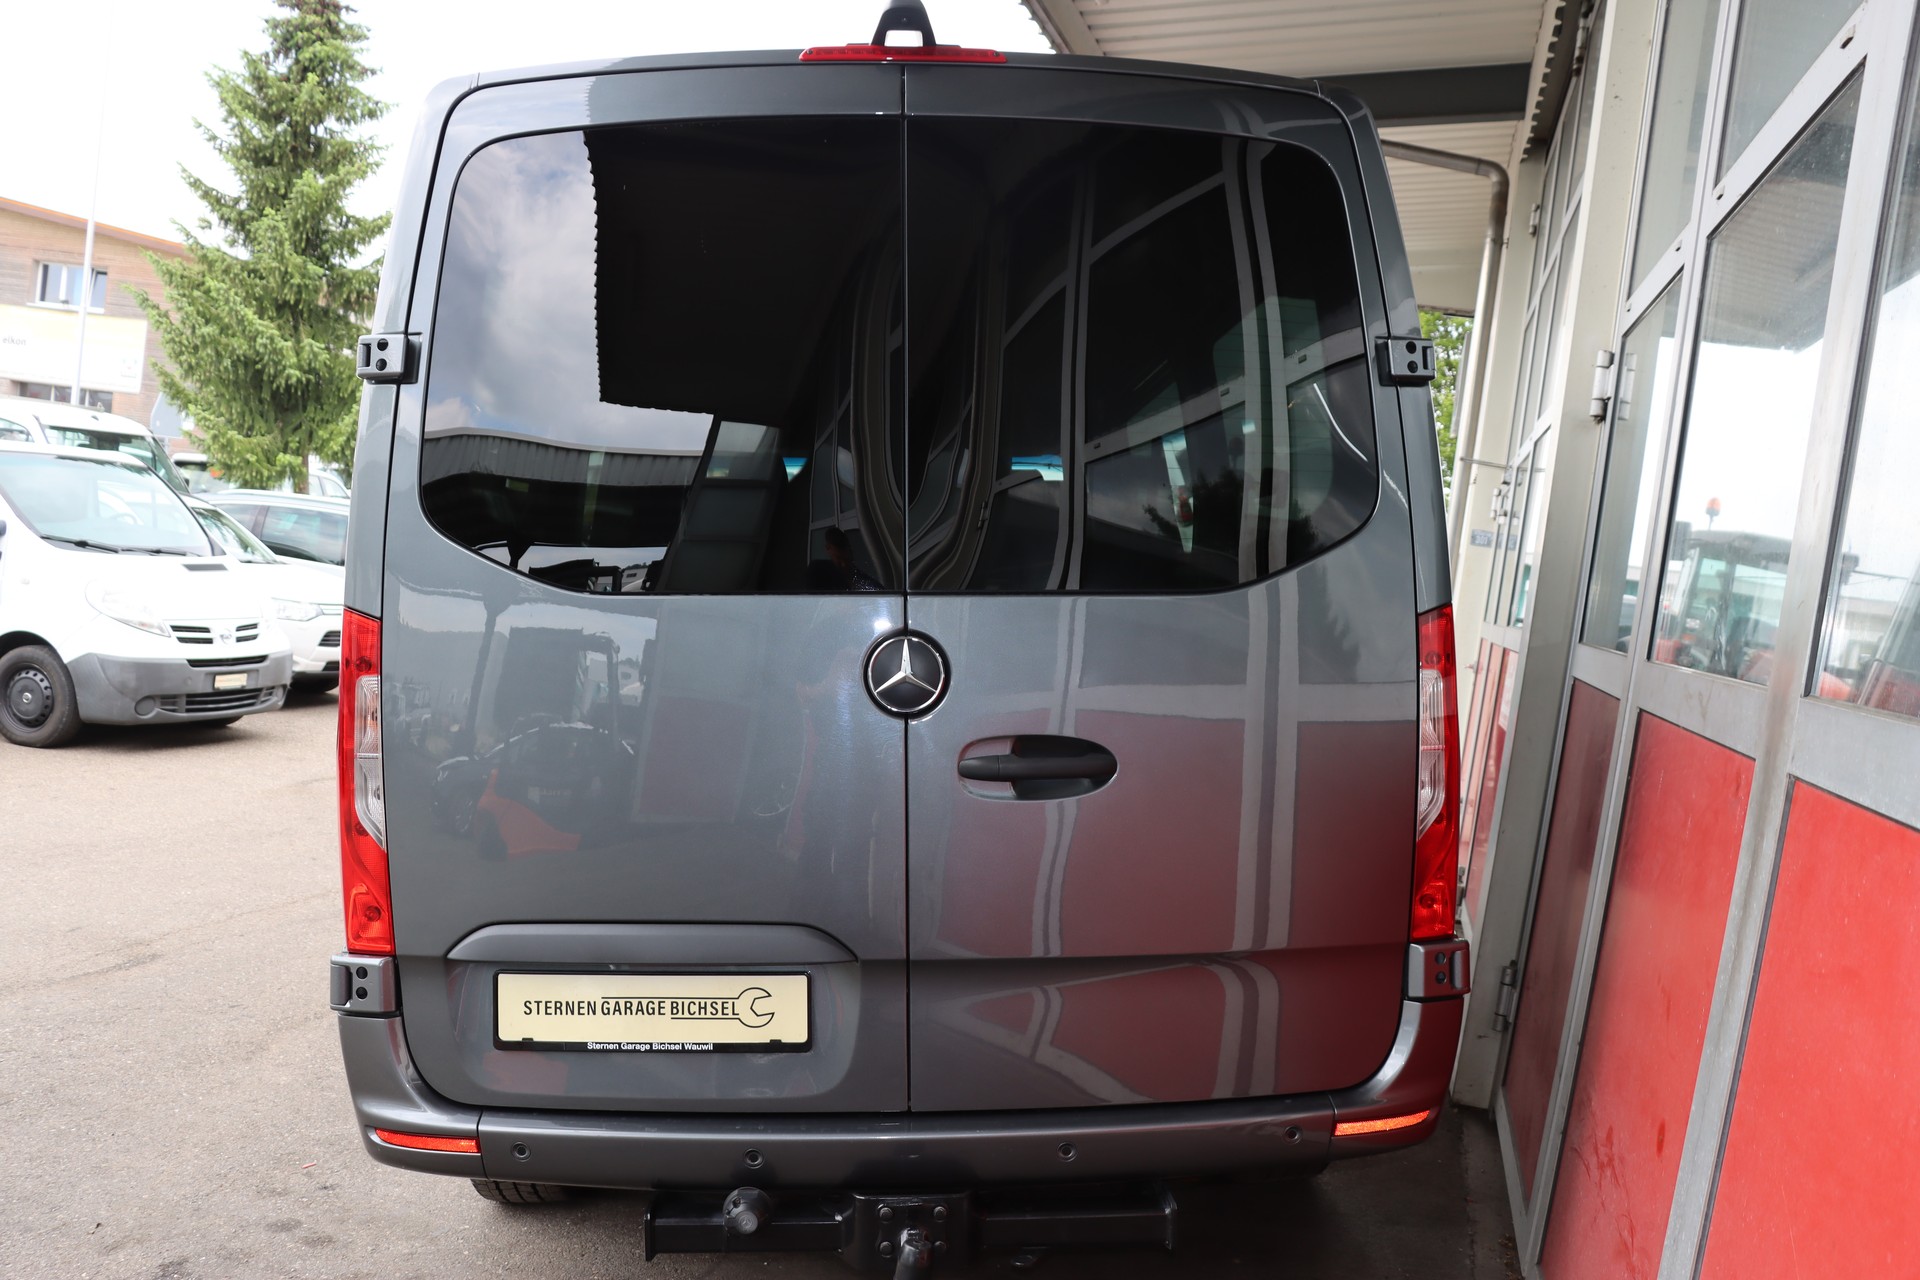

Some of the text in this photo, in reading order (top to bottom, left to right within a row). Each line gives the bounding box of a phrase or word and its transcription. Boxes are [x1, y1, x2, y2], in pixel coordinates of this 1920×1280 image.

[524, 1000, 740, 1016] STERNEN GARAGE BICHSEL
[587, 1041, 714, 1052] Sternen Garage Bichsel Wauwil
